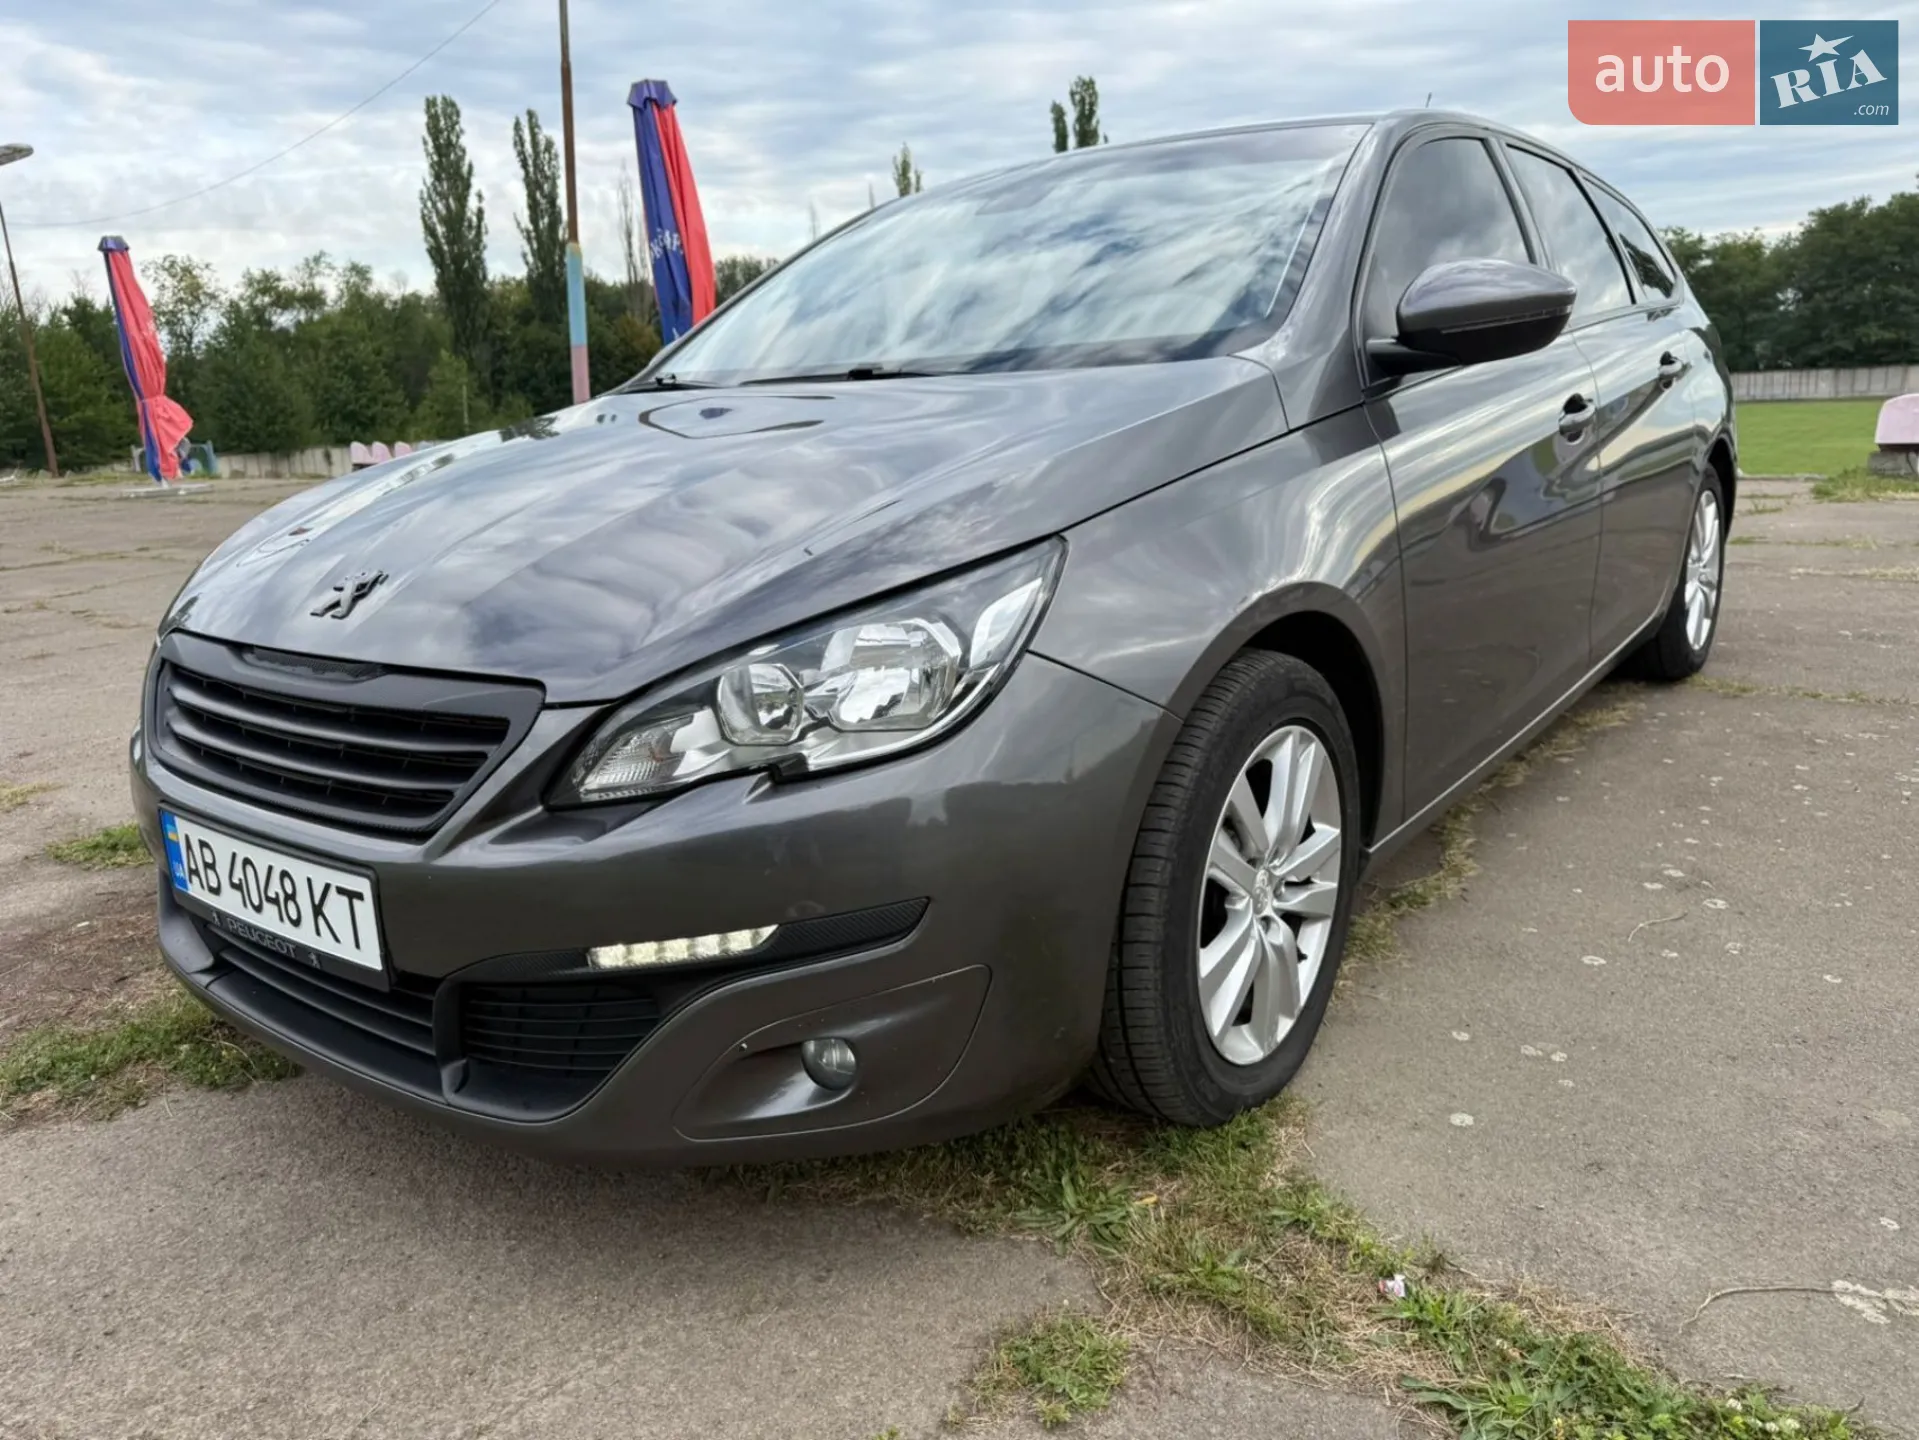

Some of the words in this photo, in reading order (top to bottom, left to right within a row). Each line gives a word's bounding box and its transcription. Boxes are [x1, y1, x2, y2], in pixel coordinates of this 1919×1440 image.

[184, 833, 221, 896] AB
[228, 851, 301, 928] 4048
[306, 876, 365, 950] KT
[226, 917, 297, 957] PEUGEOT
